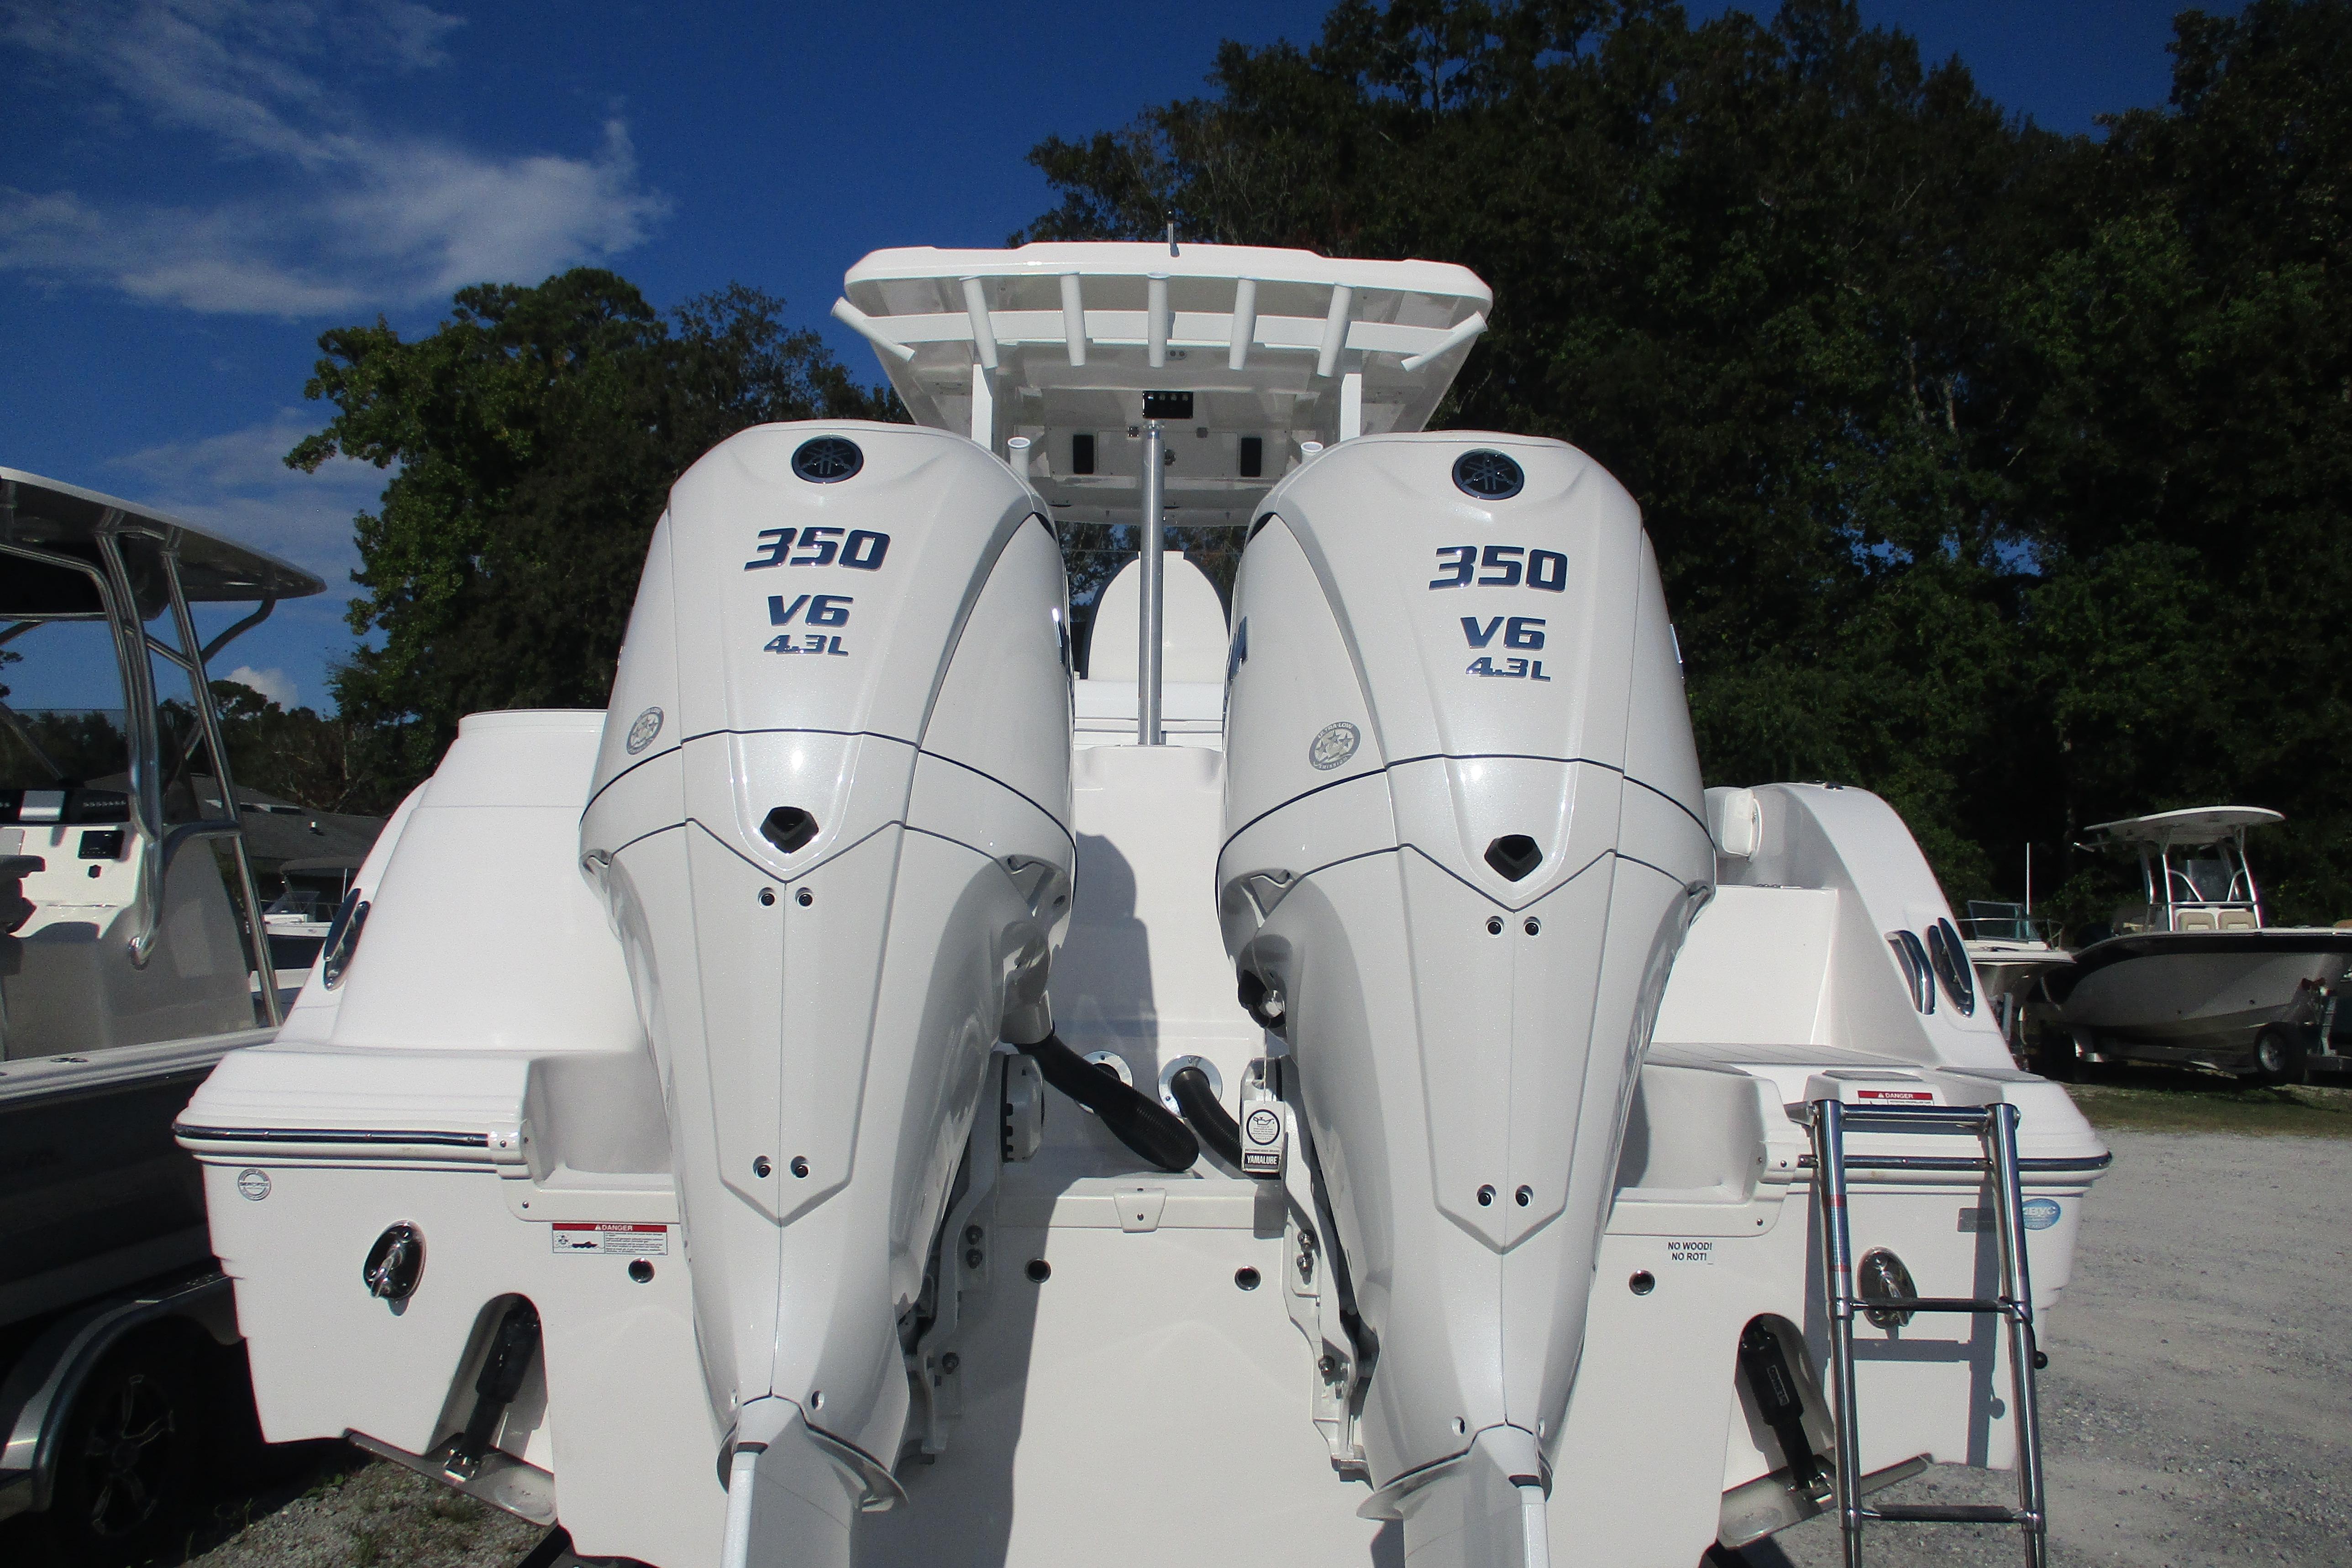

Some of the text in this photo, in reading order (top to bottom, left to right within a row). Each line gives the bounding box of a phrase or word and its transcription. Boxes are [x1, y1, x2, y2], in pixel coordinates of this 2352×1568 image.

[744, 527, 891, 572] 350
[1428, 545, 1568, 593] 350
[767, 594, 854, 628] V6
[763, 635, 849, 656] 4.3L
[1460, 616, 1546, 651] V6
[1466, 657, 1551, 682] 4.3L
[1247, 1155, 1277, 1164] YAMALUBE
[1668, 1242, 1680, 1250] NO
